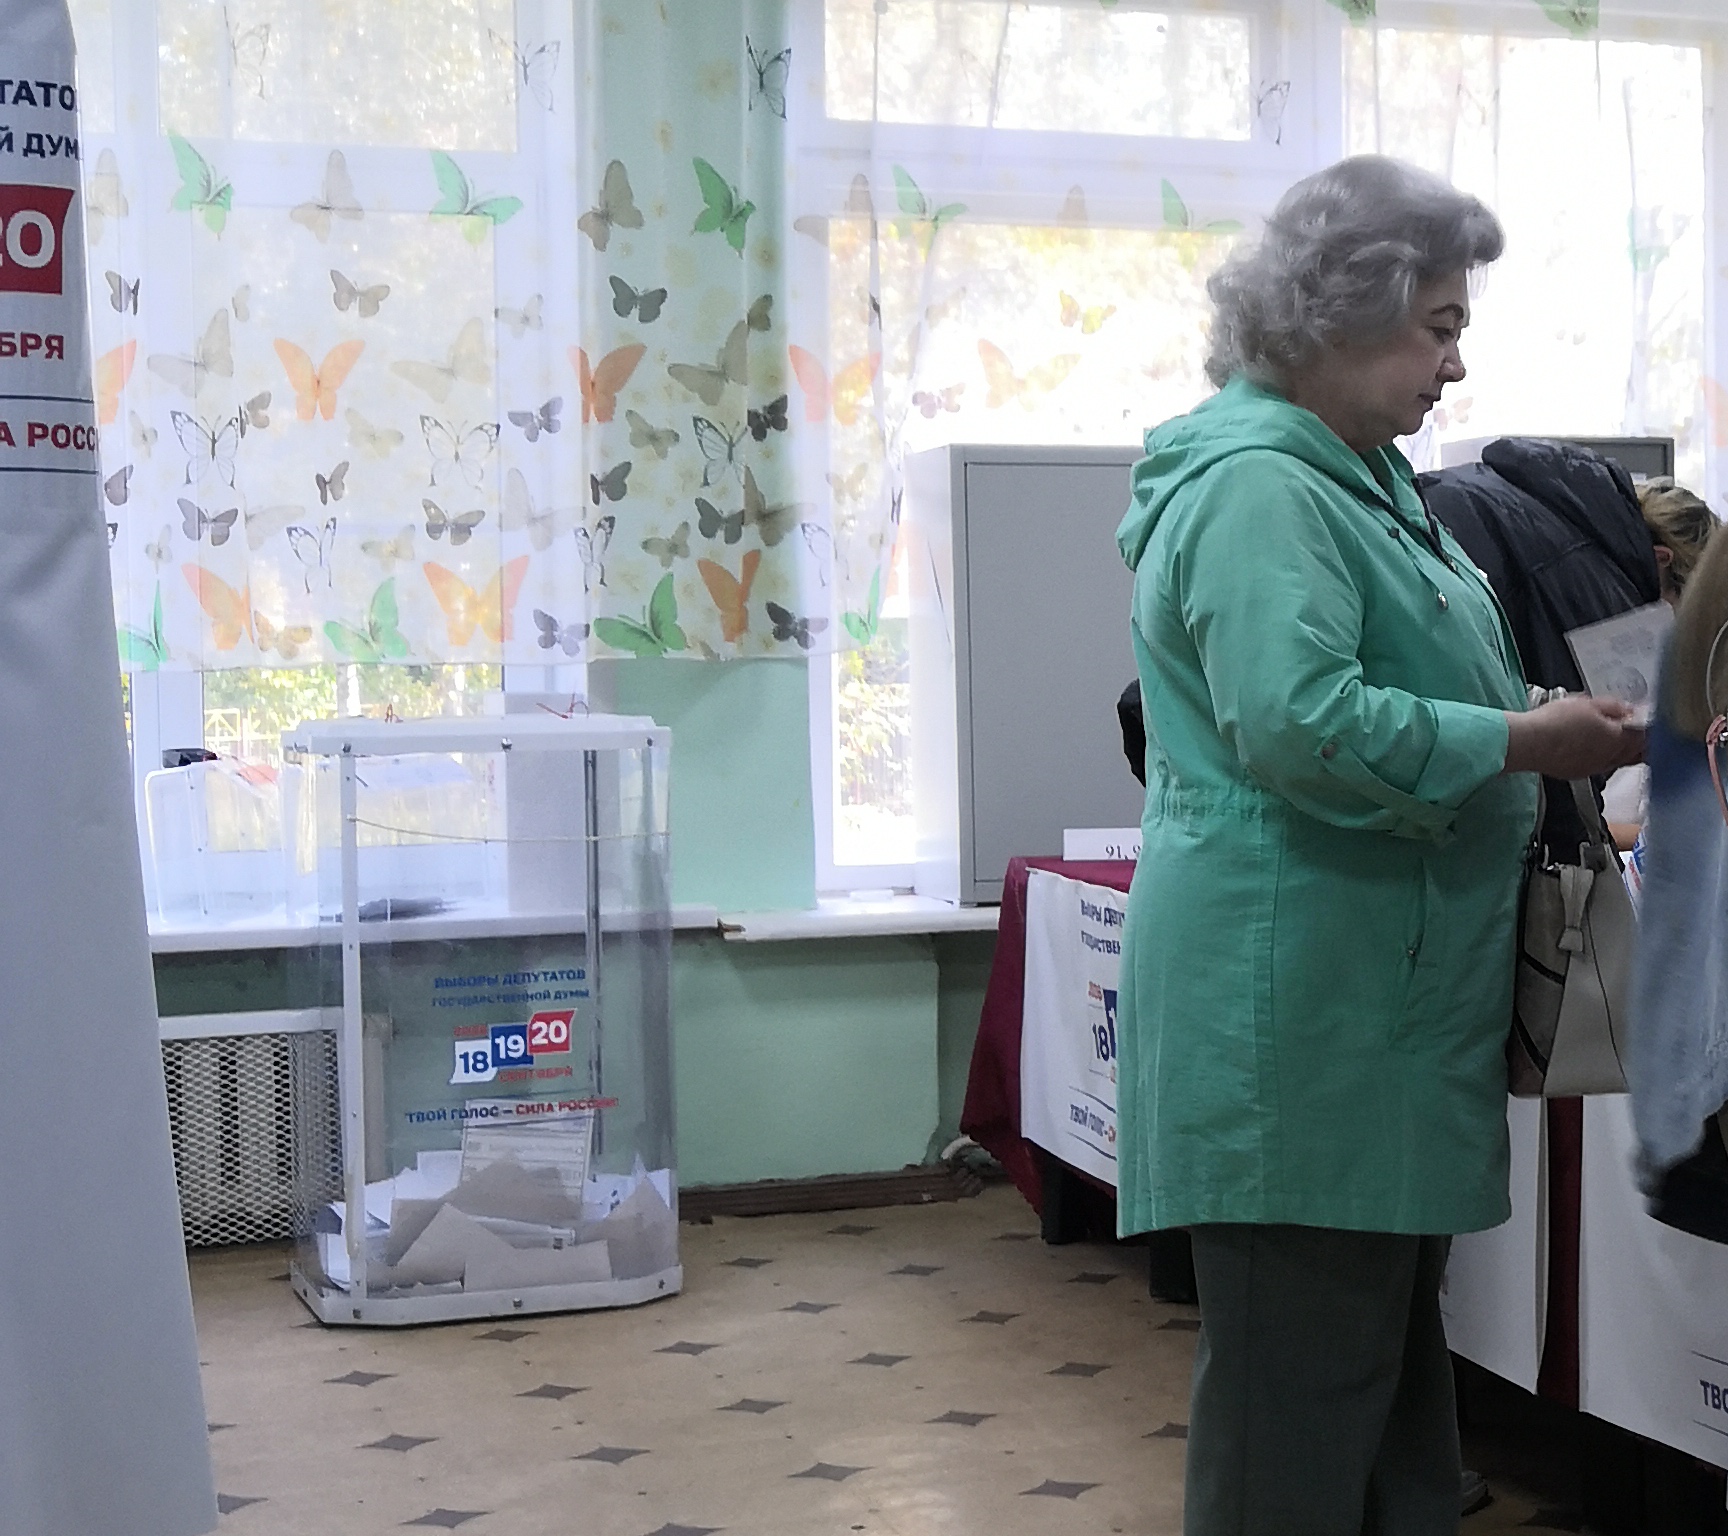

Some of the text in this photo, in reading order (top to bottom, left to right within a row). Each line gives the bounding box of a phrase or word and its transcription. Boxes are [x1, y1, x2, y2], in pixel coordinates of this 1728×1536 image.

[27, 421, 98, 452] РОСС
[459, 1020, 568, 1074] 18 19 20
[451, 1106, 498, 1120] ГОЛОС
[516, 1102, 554, 1115] СИЛА
